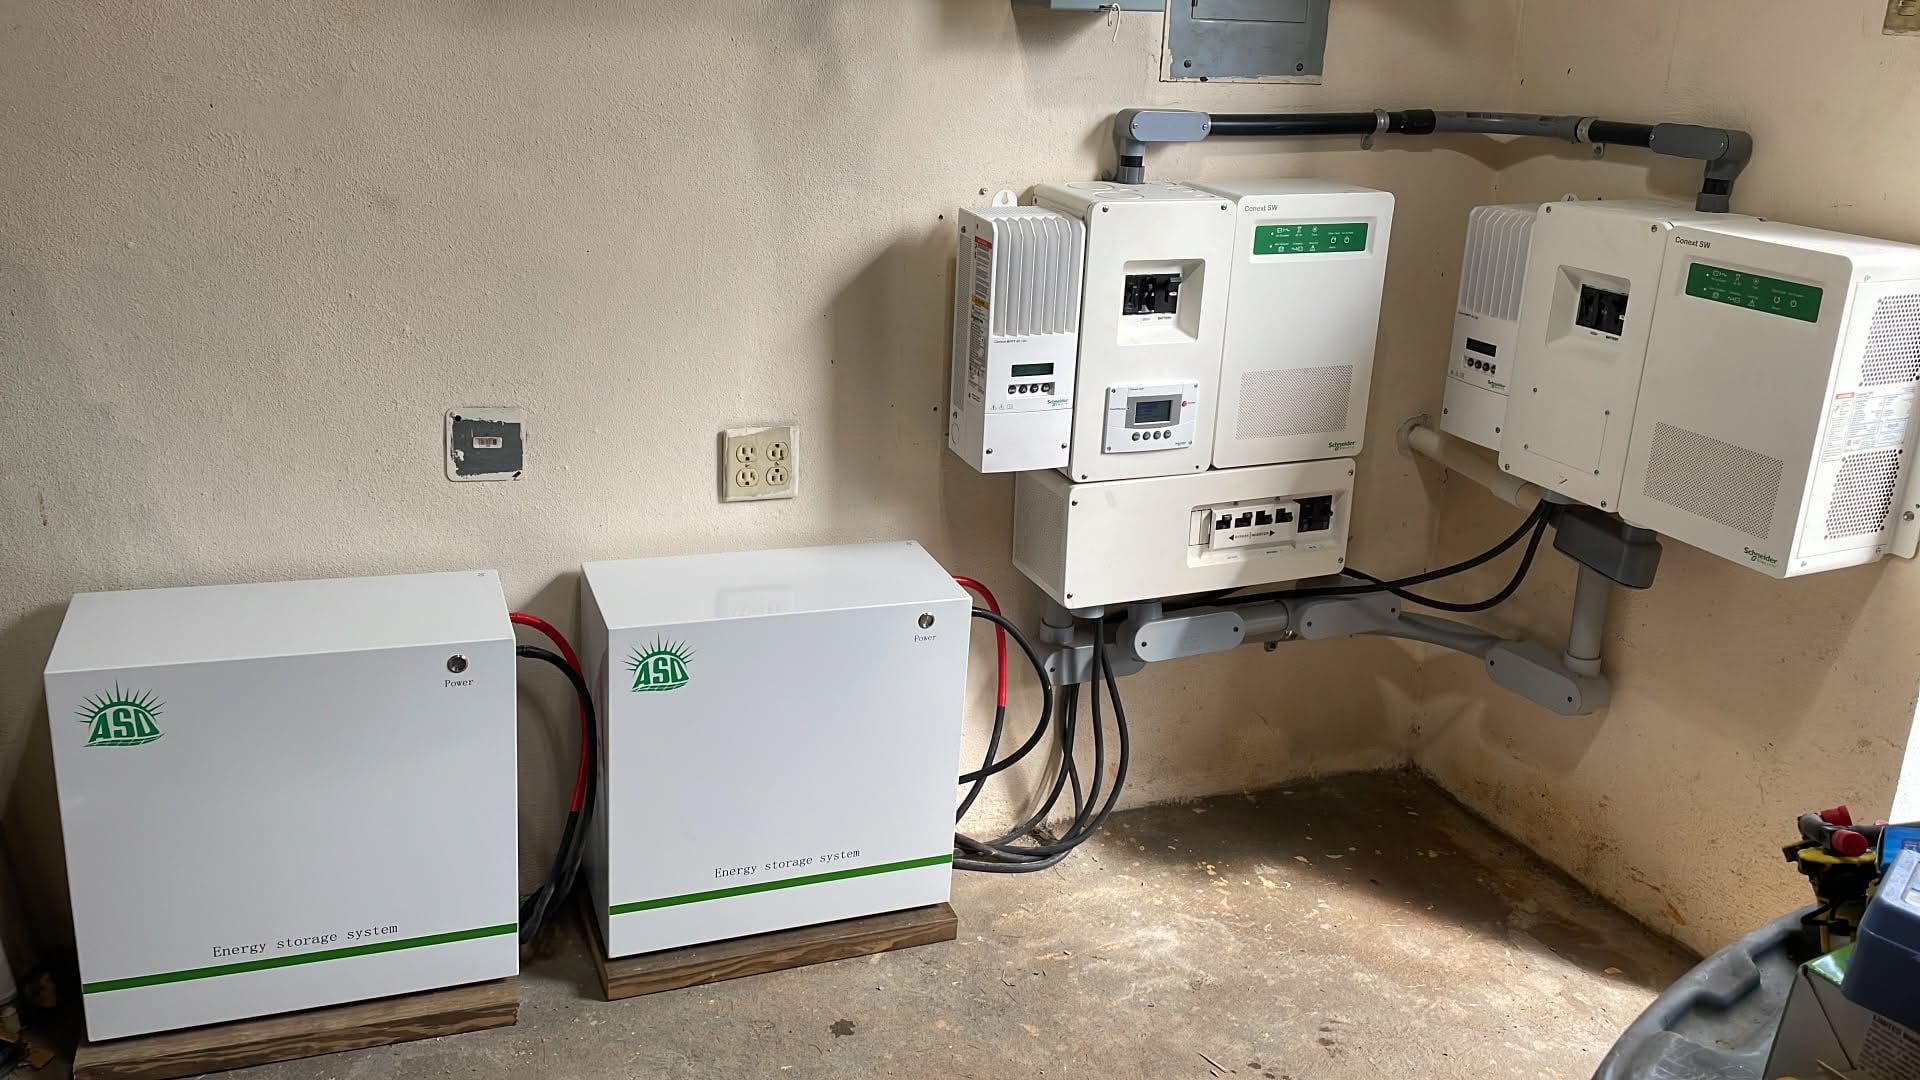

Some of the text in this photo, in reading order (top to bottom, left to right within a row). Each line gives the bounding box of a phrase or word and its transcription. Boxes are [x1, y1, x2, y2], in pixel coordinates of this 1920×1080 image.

[1244, 204, 1267, 212] Conext
[1675, 236, 1711, 249] Conext SW
[1328, 440, 1356, 449] Schneider
[1743, 546, 1778, 564] Schneider
[914, 634, 937, 643] Power
[632, 656, 690, 690] ASD
[444, 679, 474, 688] Power
[88, 707, 160, 743] ASD
[714, 849, 861, 879] Energy storage system
[212, 924, 399, 958] Energy storage system
